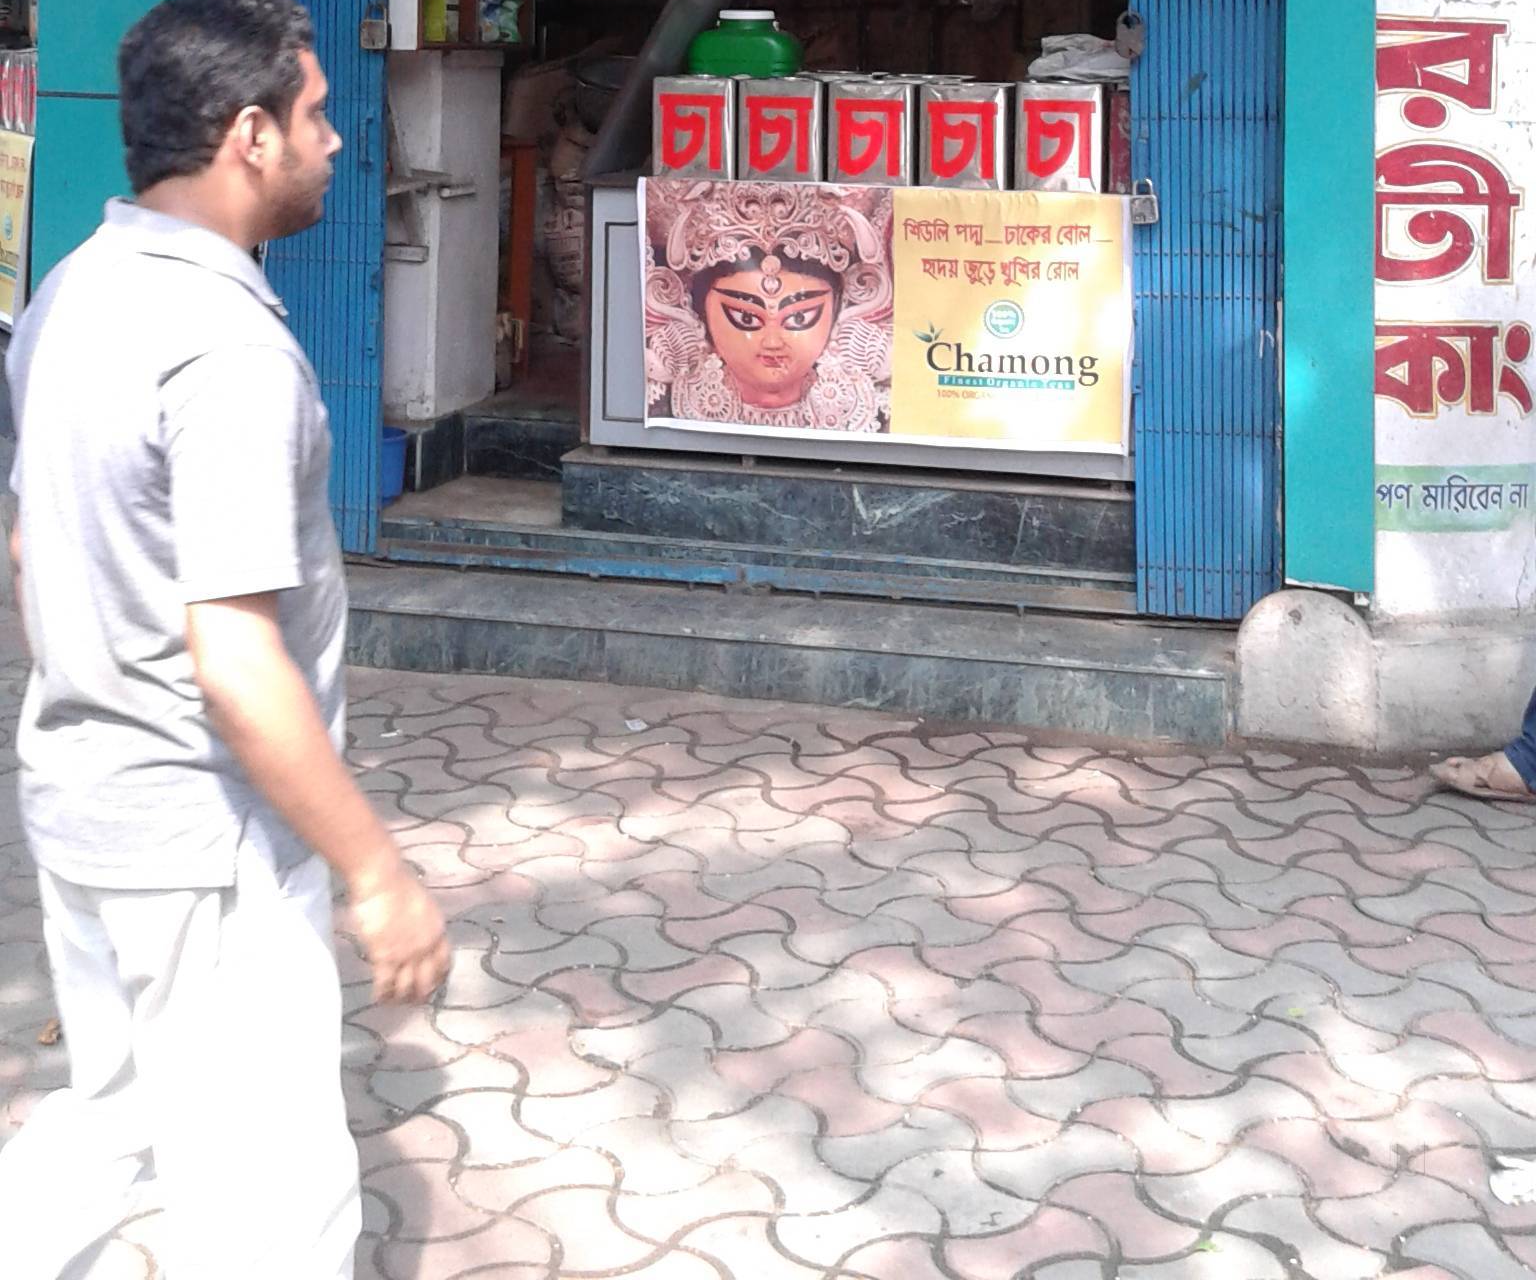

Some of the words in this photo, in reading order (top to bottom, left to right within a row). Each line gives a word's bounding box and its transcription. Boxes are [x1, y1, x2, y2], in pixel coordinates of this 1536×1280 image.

[659, 94, 724, 172] চা
[746, 95, 813, 172] চা
[836, 99, 903, 177] চা
[927, 101, 998, 179] চা
[1023, 100, 1096, 179] চা
[903, 218, 949, 243] শিউলি
[1004, 224, 1051, 245] ঢাকের
[1056, 224, 1091, 246] বোল
[922, 258, 958, 280] হৃদয়
[964, 260, 995, 286] জুড়ে
[1000, 256, 1041, 286] খুশির
[1046, 261, 1079, 281] রোল
[927, 342, 1099, 387] Chamong
[943, 376, 983, 385] Finest
[1422, 474, 1504, 513] মারিবেন
[1509, 483, 1528, 509] না
